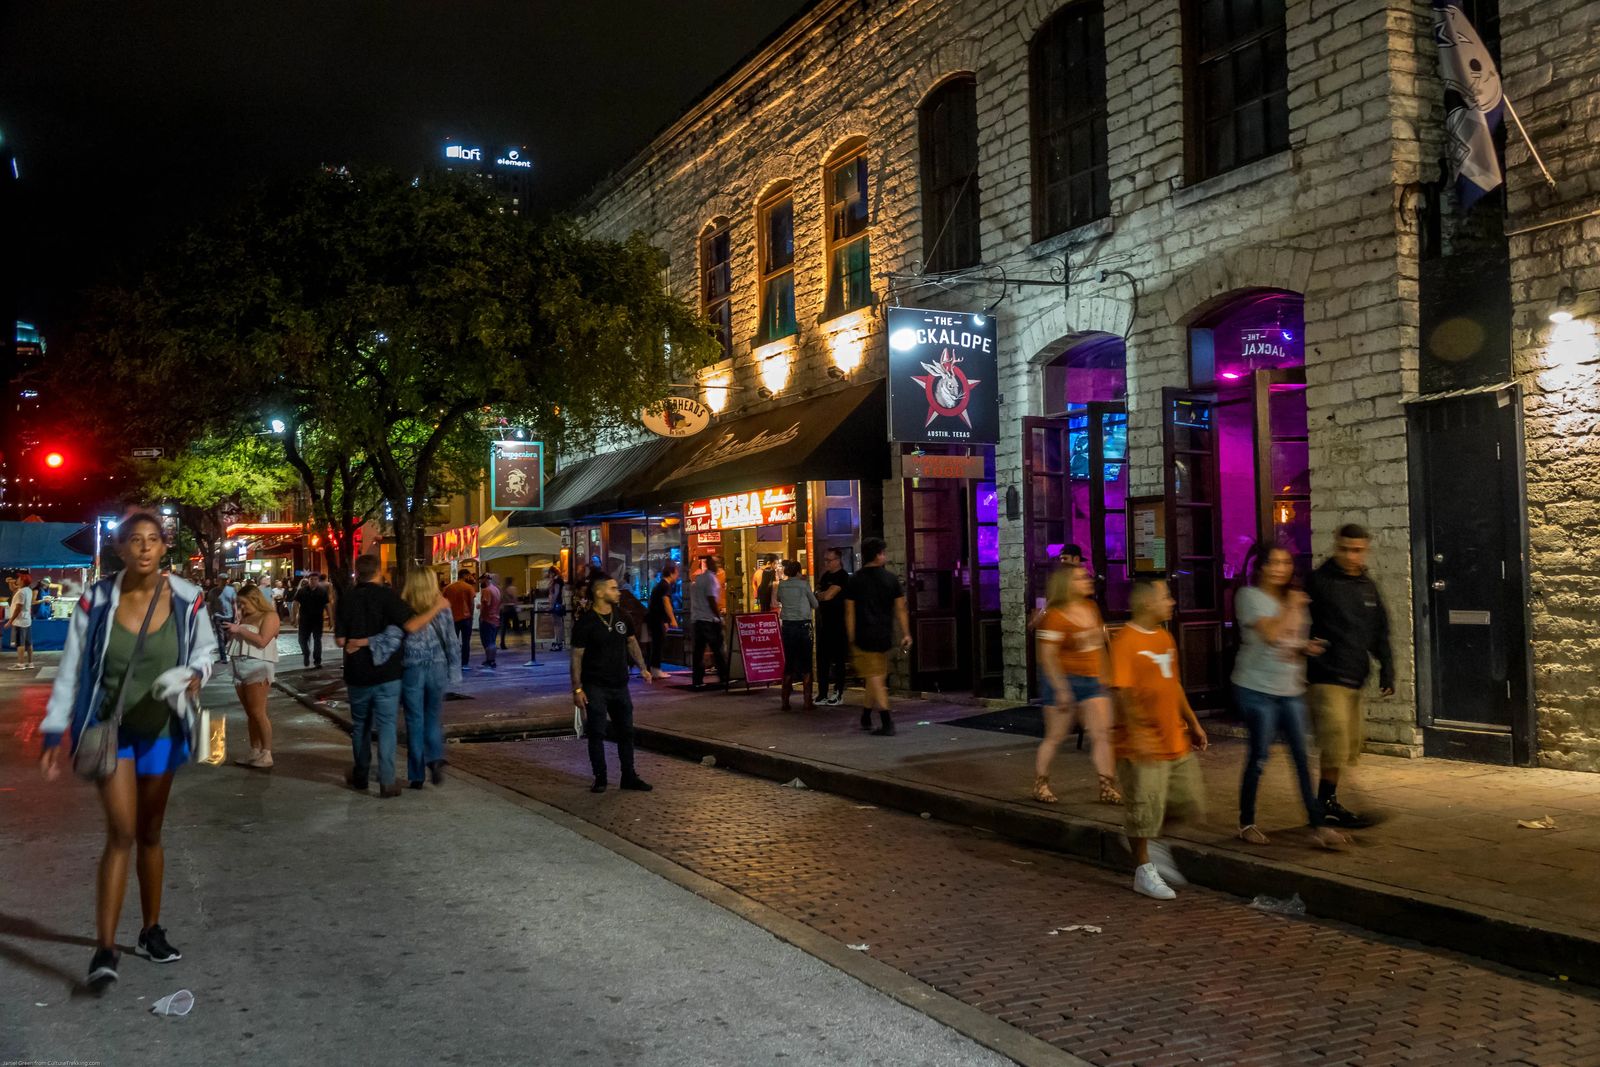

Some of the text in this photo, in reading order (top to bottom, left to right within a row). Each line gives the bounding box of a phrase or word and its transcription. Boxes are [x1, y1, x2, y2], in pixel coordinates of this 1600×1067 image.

[497, 158, 531, 168] element
[934, 316, 953, 326] THE
[916, 328, 992, 354] CKALOPE
[927, 430, 951, 438] AUSTIN,
[709, 492, 763, 529] PIZZA
